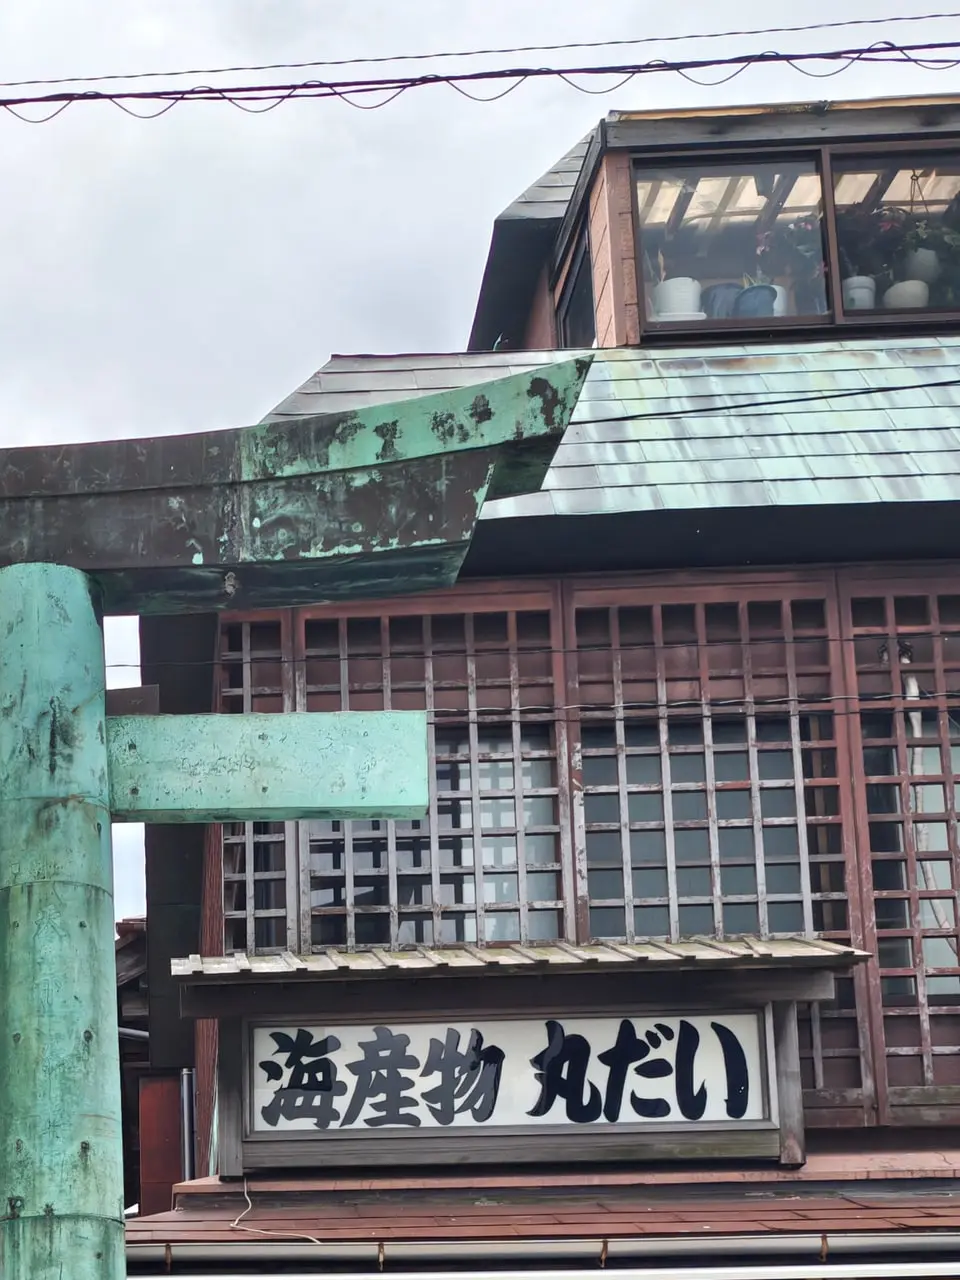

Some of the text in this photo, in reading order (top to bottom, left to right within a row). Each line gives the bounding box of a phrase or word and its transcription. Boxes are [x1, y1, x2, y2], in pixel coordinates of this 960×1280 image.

[258, 1018, 750, 1130] 海産物 丸だい
